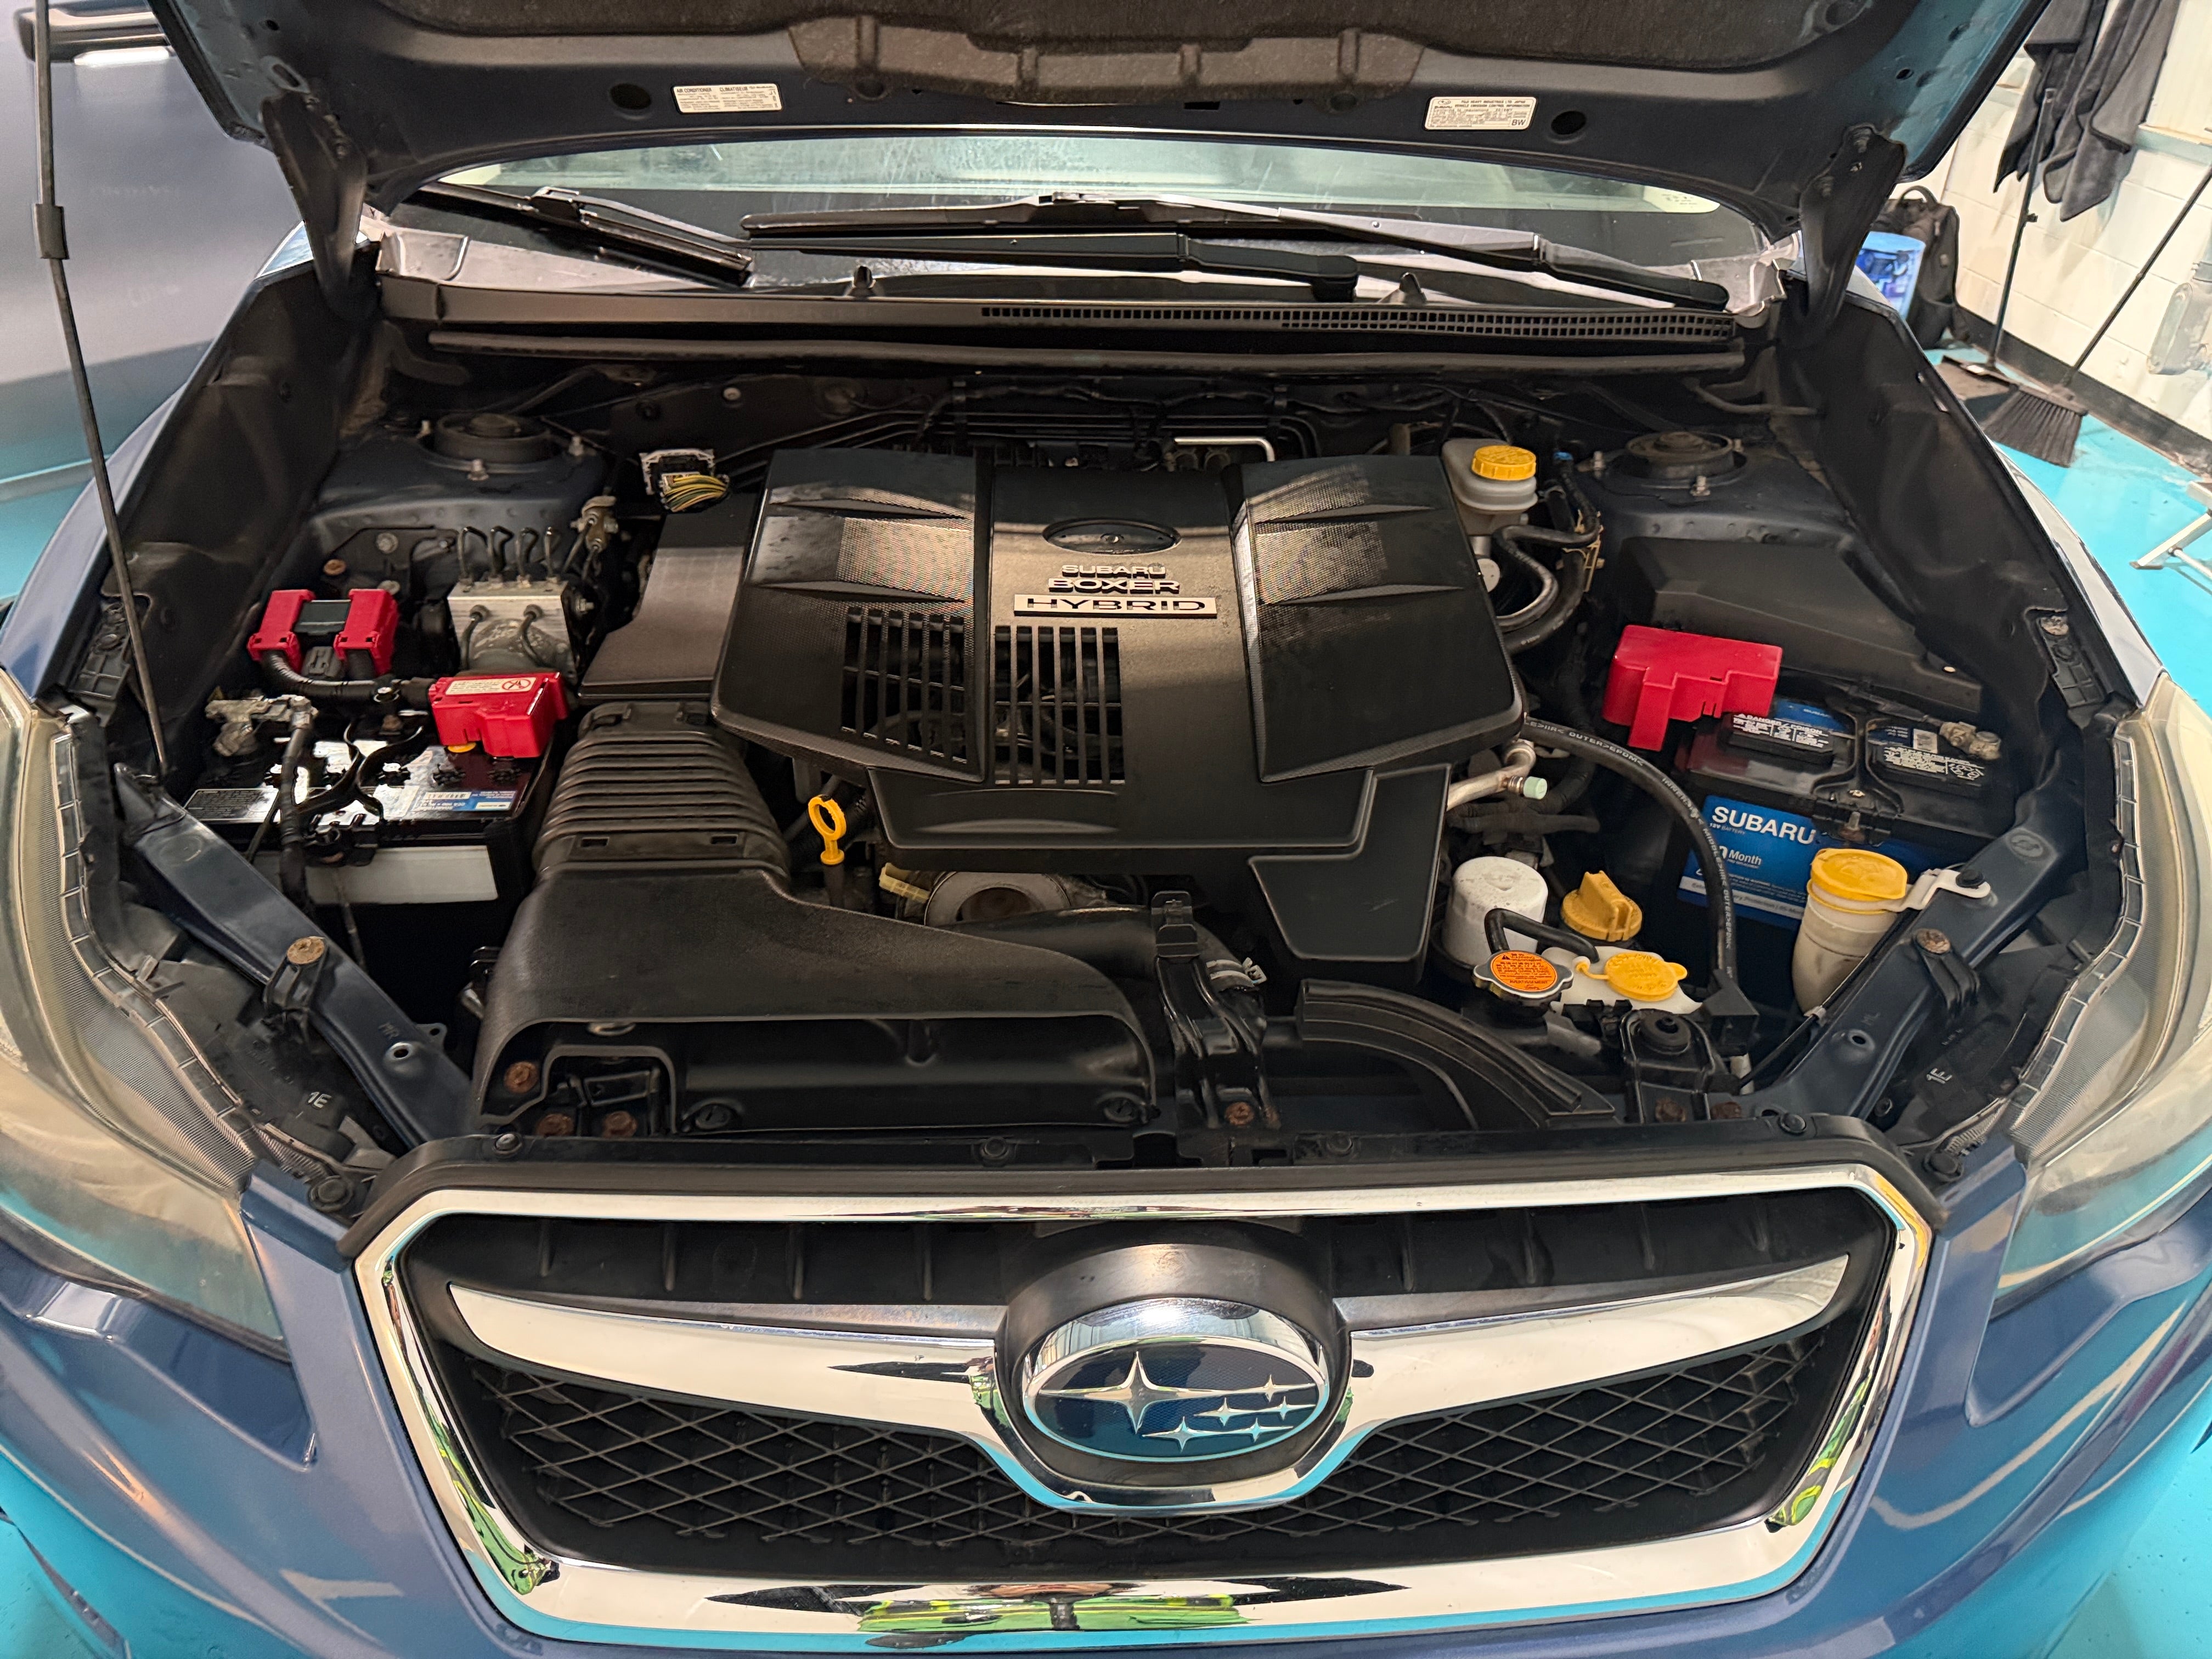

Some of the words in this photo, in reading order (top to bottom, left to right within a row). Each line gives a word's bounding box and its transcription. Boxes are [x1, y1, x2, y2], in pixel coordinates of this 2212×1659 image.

[1062, 565, 1166, 577] SUBARU
[1048, 578, 1180, 594] BOXER
[1027, 598, 1206, 611] HYBRID
[1712, 806, 1816, 845] SUBARU
[1728, 849, 1762, 866] Month
[307, 1091, 332, 1109] 1E
